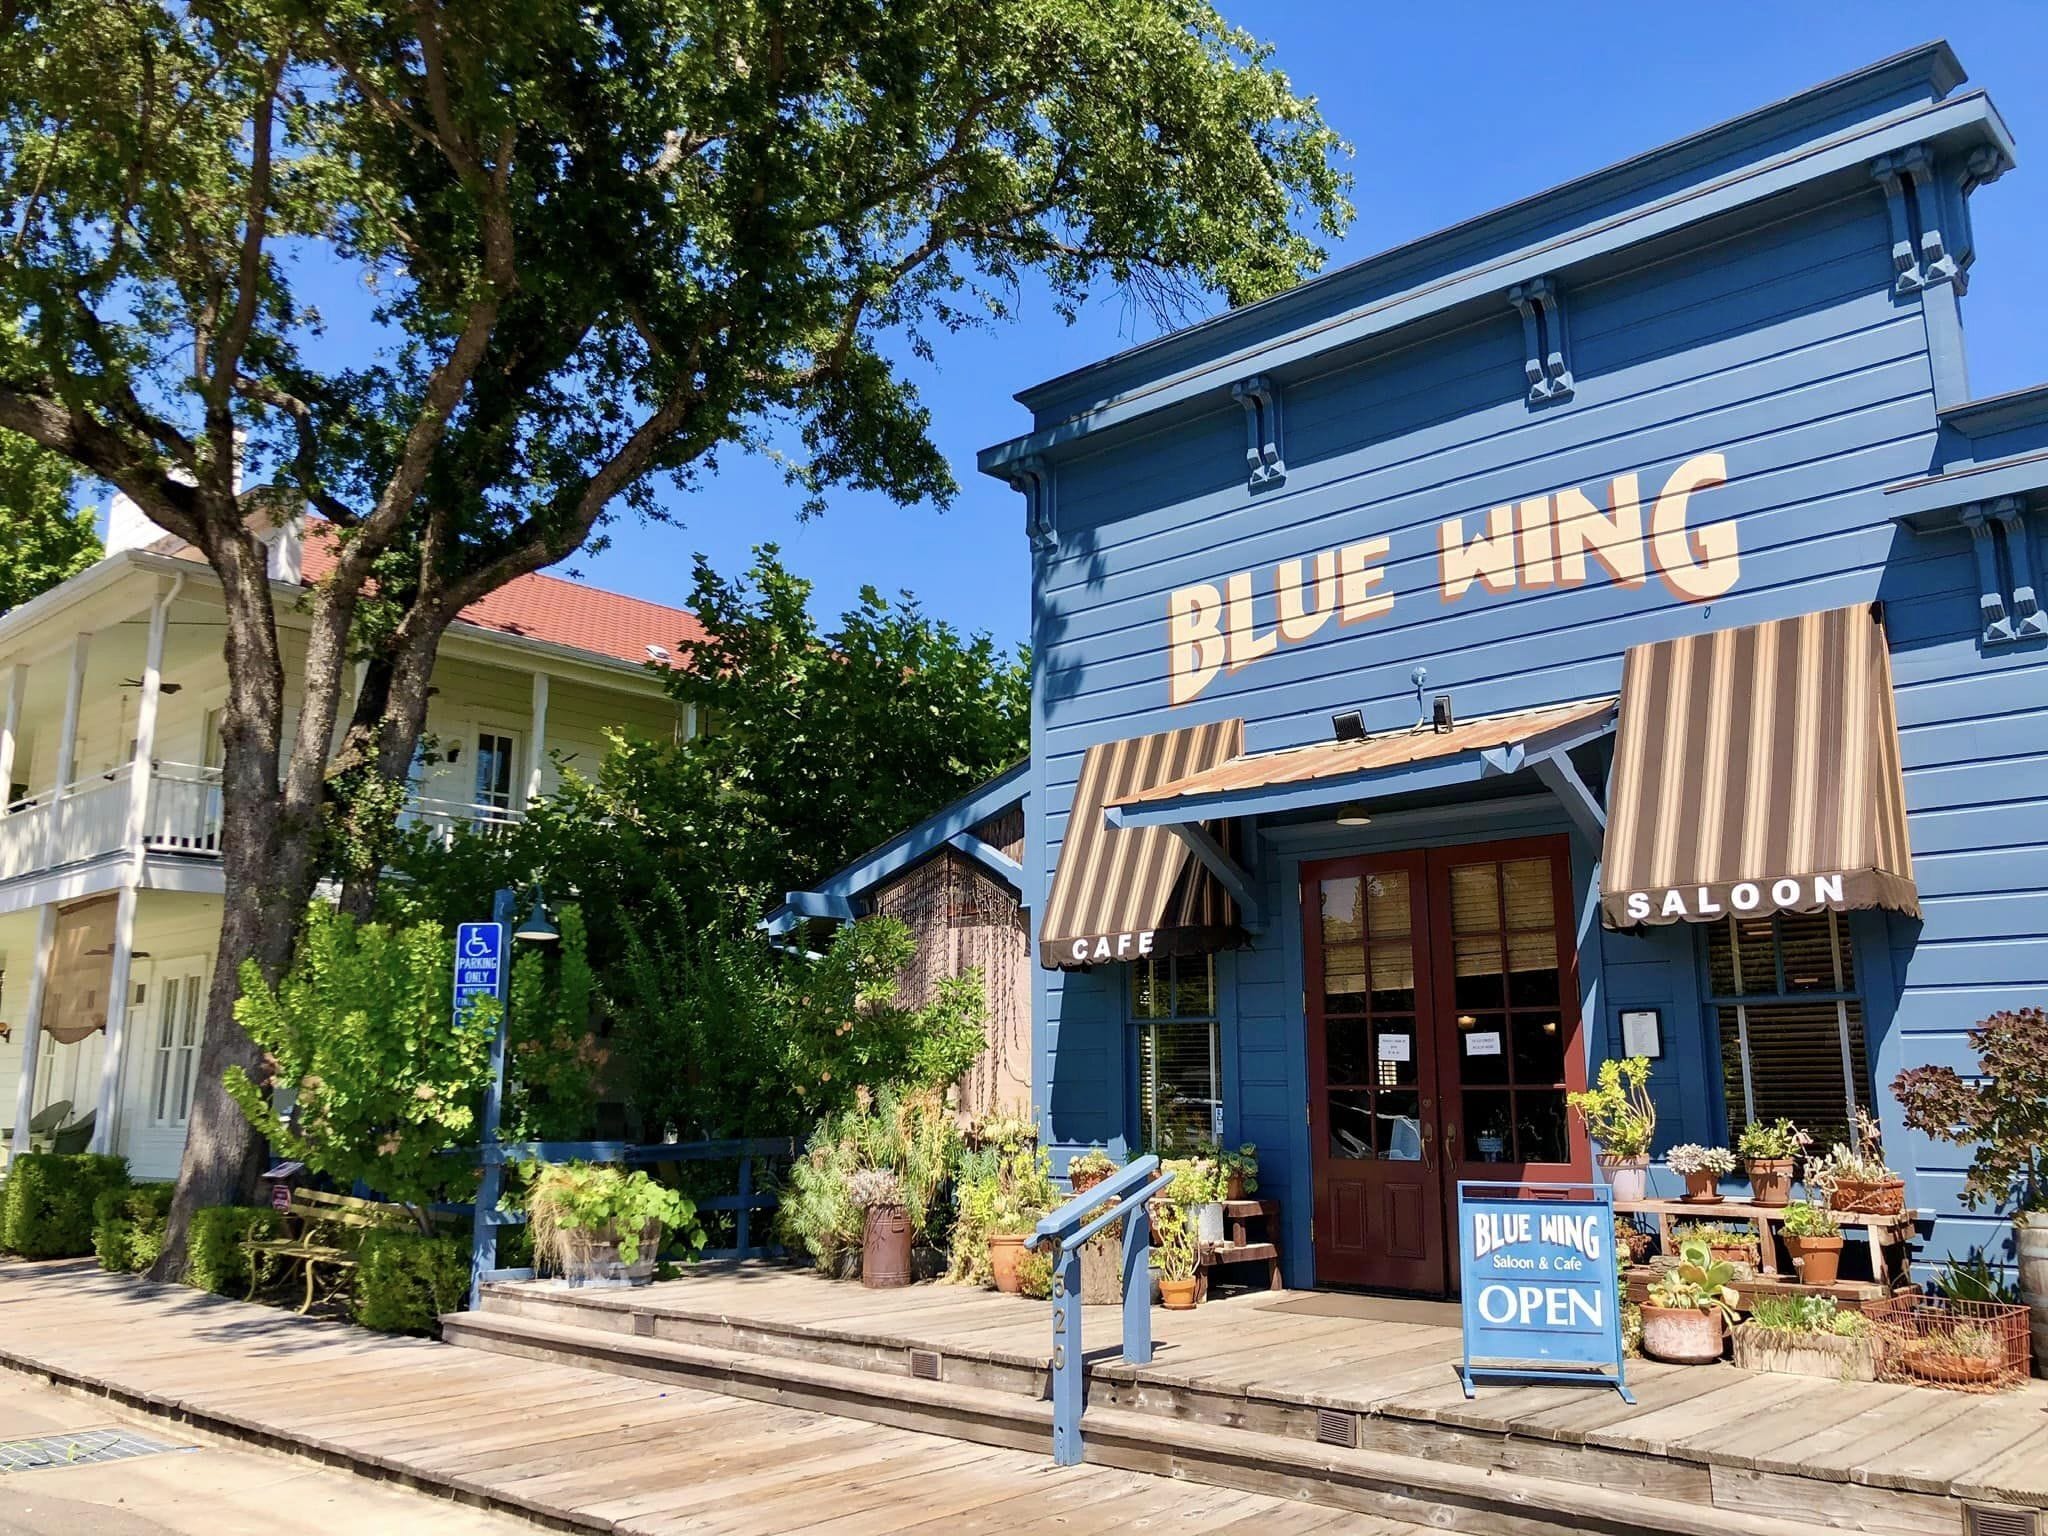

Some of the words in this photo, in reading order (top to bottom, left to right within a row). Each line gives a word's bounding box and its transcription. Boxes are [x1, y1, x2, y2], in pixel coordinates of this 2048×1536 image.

[1169, 536, 1394, 707] BLUE
[1437, 453, 1741, 602] WING
[1627, 874, 1844, 919] SALOON
[459, 957, 497, 969] PARKING
[1072, 931, 1154, 960] CAFE
[465, 971, 489, 983] ONLY
[1474, 1213, 1532, 1260] BLUE
[1540, 1214, 1600, 1261] WING
[1493, 1254, 1534, 1269] Saloon
[1538, 1256, 1549, 1270] &
[1553, 1256, 1582, 1271] Cafe
[1478, 1284, 1603, 1327] OPEN
